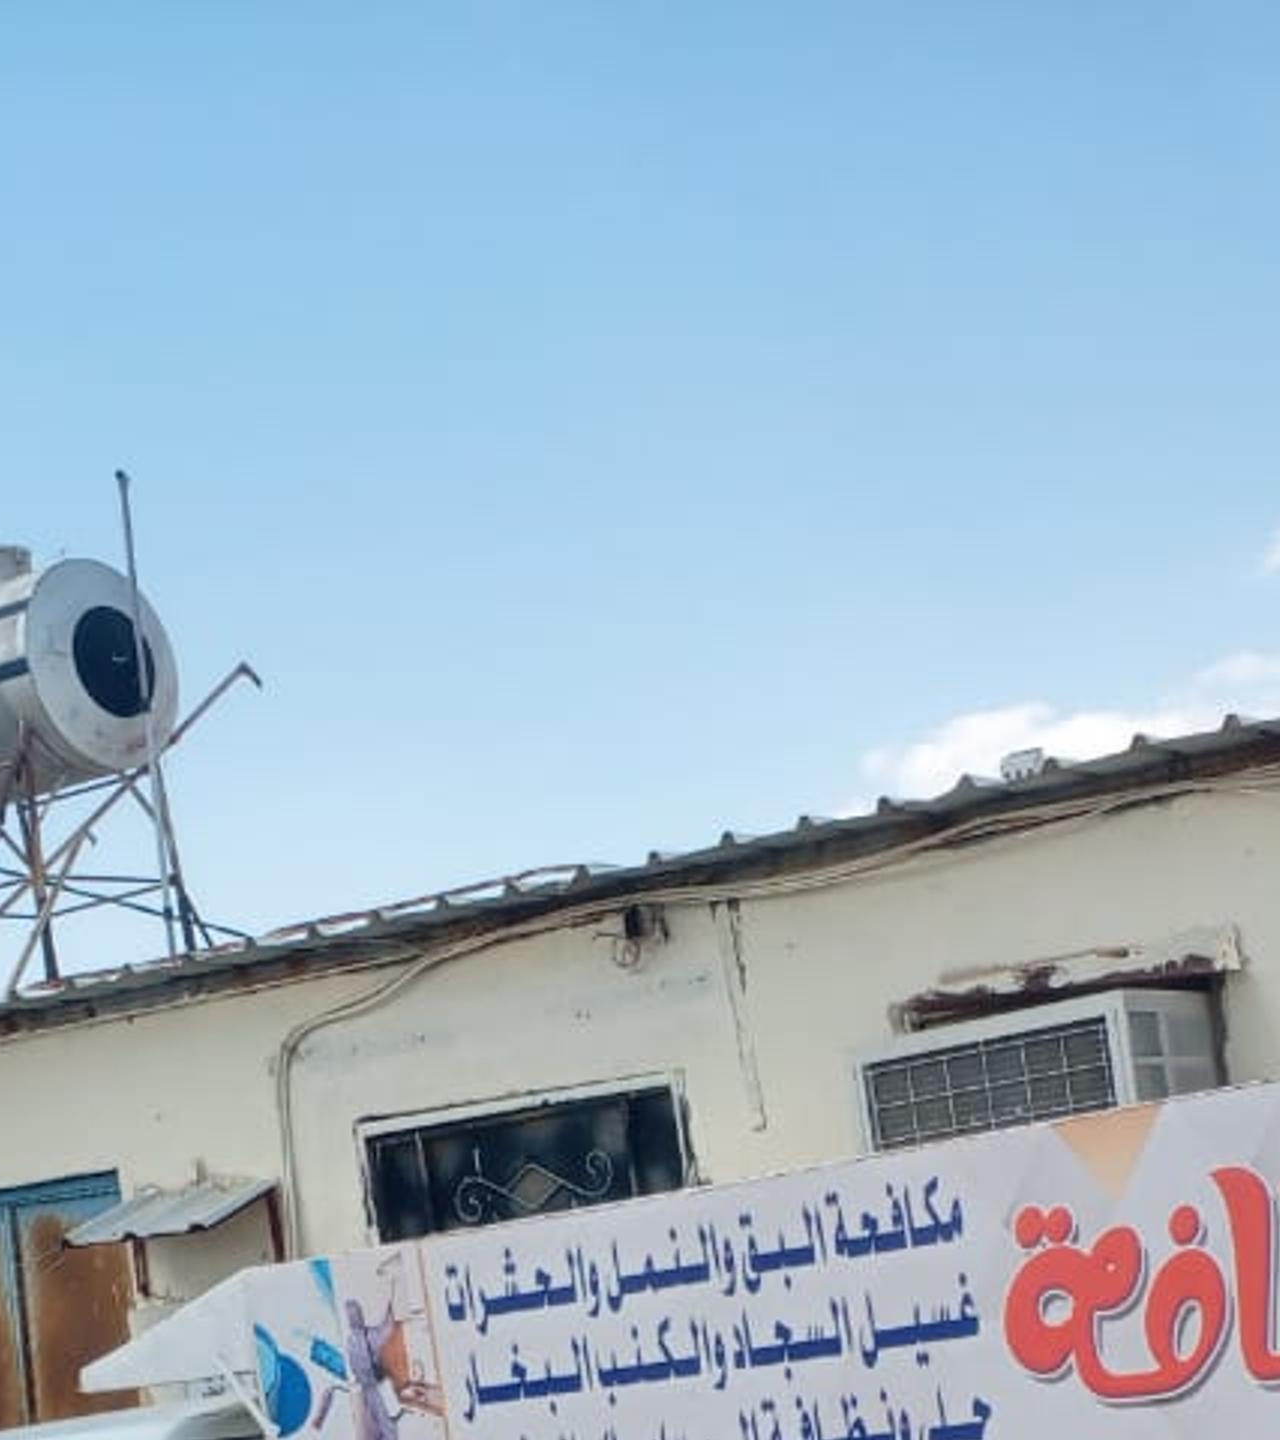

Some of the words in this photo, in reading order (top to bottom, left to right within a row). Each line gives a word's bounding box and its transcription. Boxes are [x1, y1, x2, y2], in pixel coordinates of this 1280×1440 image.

[738, 1193, 827, 1294] البق
[826, 1175, 965, 1257] مكافحة
[445, 1244, 600, 1333] والحشرات
[606, 1217, 735, 1314] والنمل
[598, 1315, 727, 1403] والكنب
[732, 1296, 856, 1378] السجاد
[860, 1271, 981, 1368] غسيل
[463, 1335, 595, 1421] البخار
